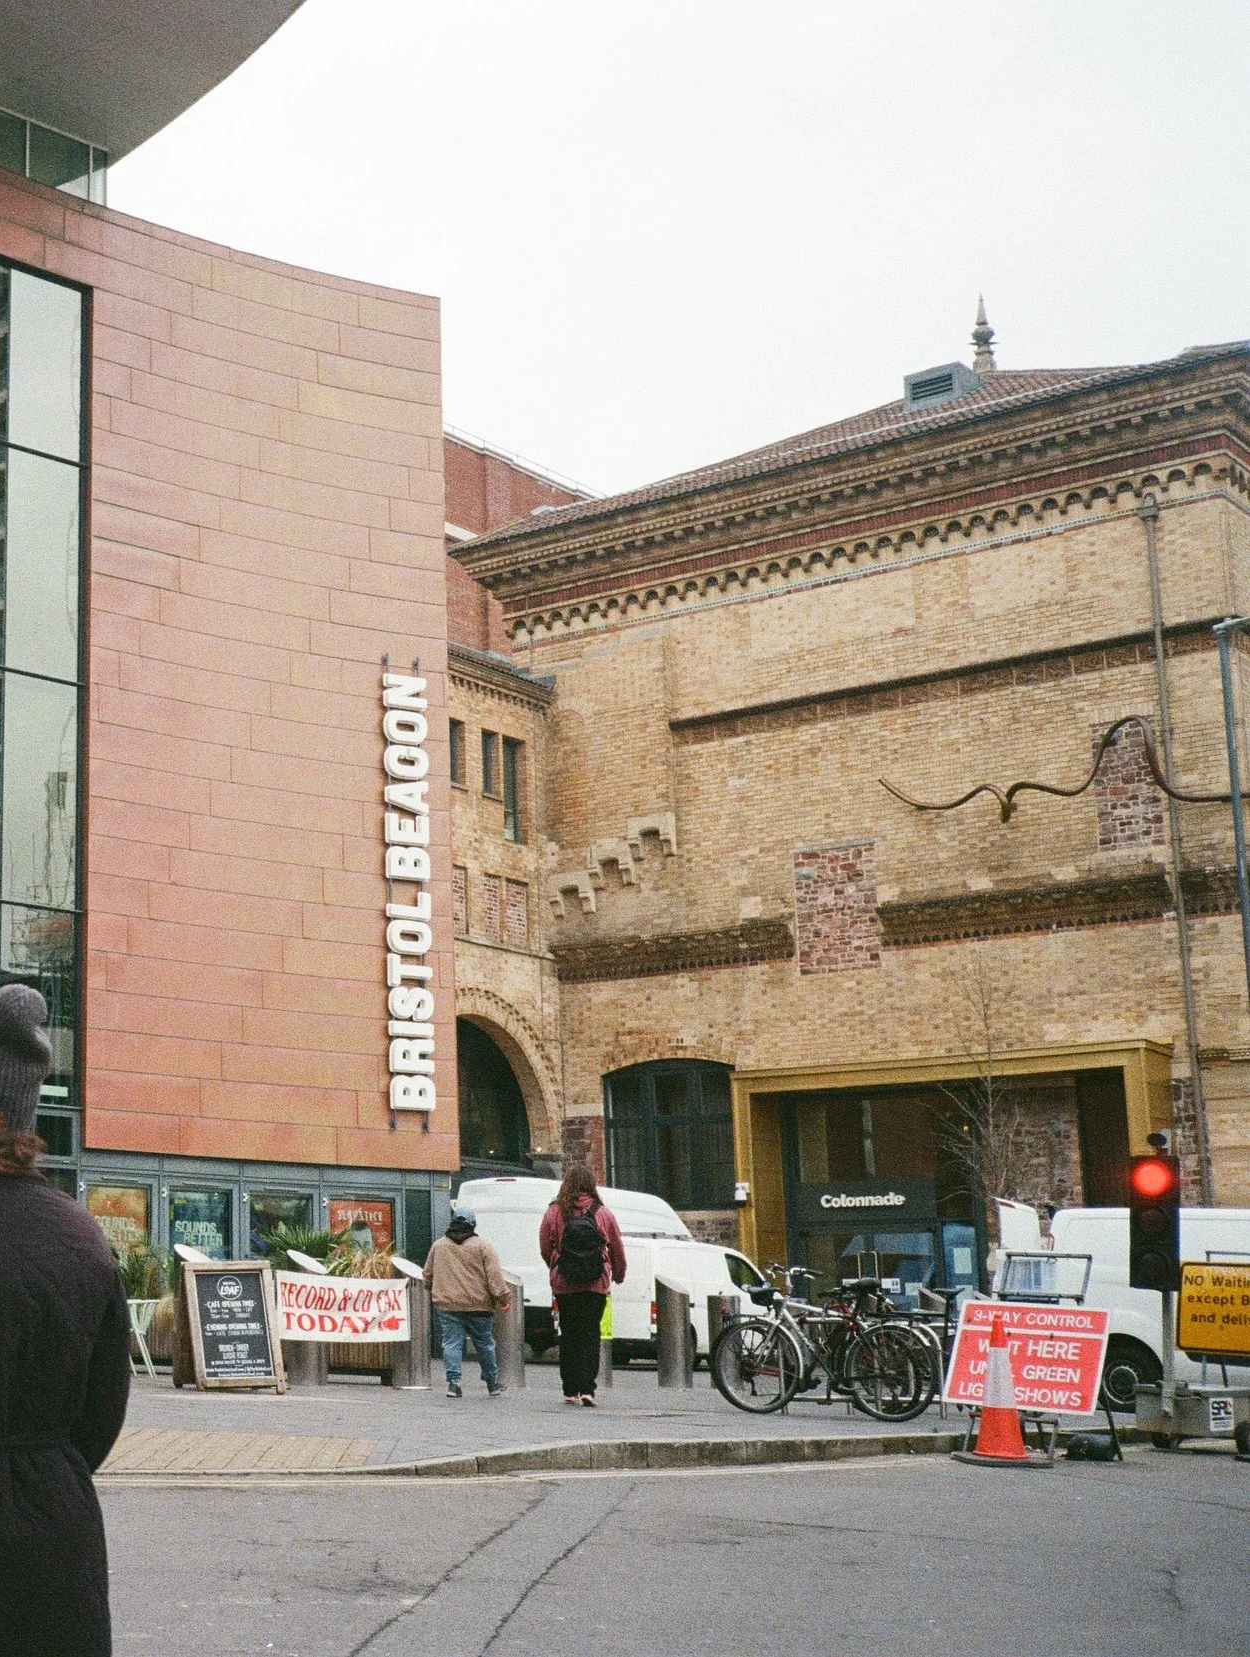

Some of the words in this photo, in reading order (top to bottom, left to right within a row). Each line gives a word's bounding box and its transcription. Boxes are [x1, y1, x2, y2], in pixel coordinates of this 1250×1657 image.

[382, 673, 431, 881] BEACON
[386, 891, 436, 1111] BRISTOL
[820, 1191, 906, 1208] Colonnade
[175, 1220, 217, 1233] SOUNDS
[183, 1232, 223, 1246] BETTER
[1184, 1275, 1204, 1286] NO
[220, 1286, 240, 1296] LOAF
[280, 1282, 337, 1312] RECORD
[338, 1288, 352, 1312] &
[353, 1288, 373, 1312] CD
[1187, 1294, 1235, 1307] except
[283, 1312, 378, 1334] TODAY
[973, 1309, 1022, 1323] 3-WAY
[1025, 1312, 1094, 1329] CONTROL
[1190, 1312, 1216, 1324] and
[1222, 1313, 1250, 1325] deli
[978, 1338, 1022, 1356] WIT
[1027, 1339, 1081, 1361] HERE
[1023, 1364, 1081, 1384] GREEN
[958, 1381, 984, 1398] LIG
[1014, 1386, 1082, 1407] SHOWS
